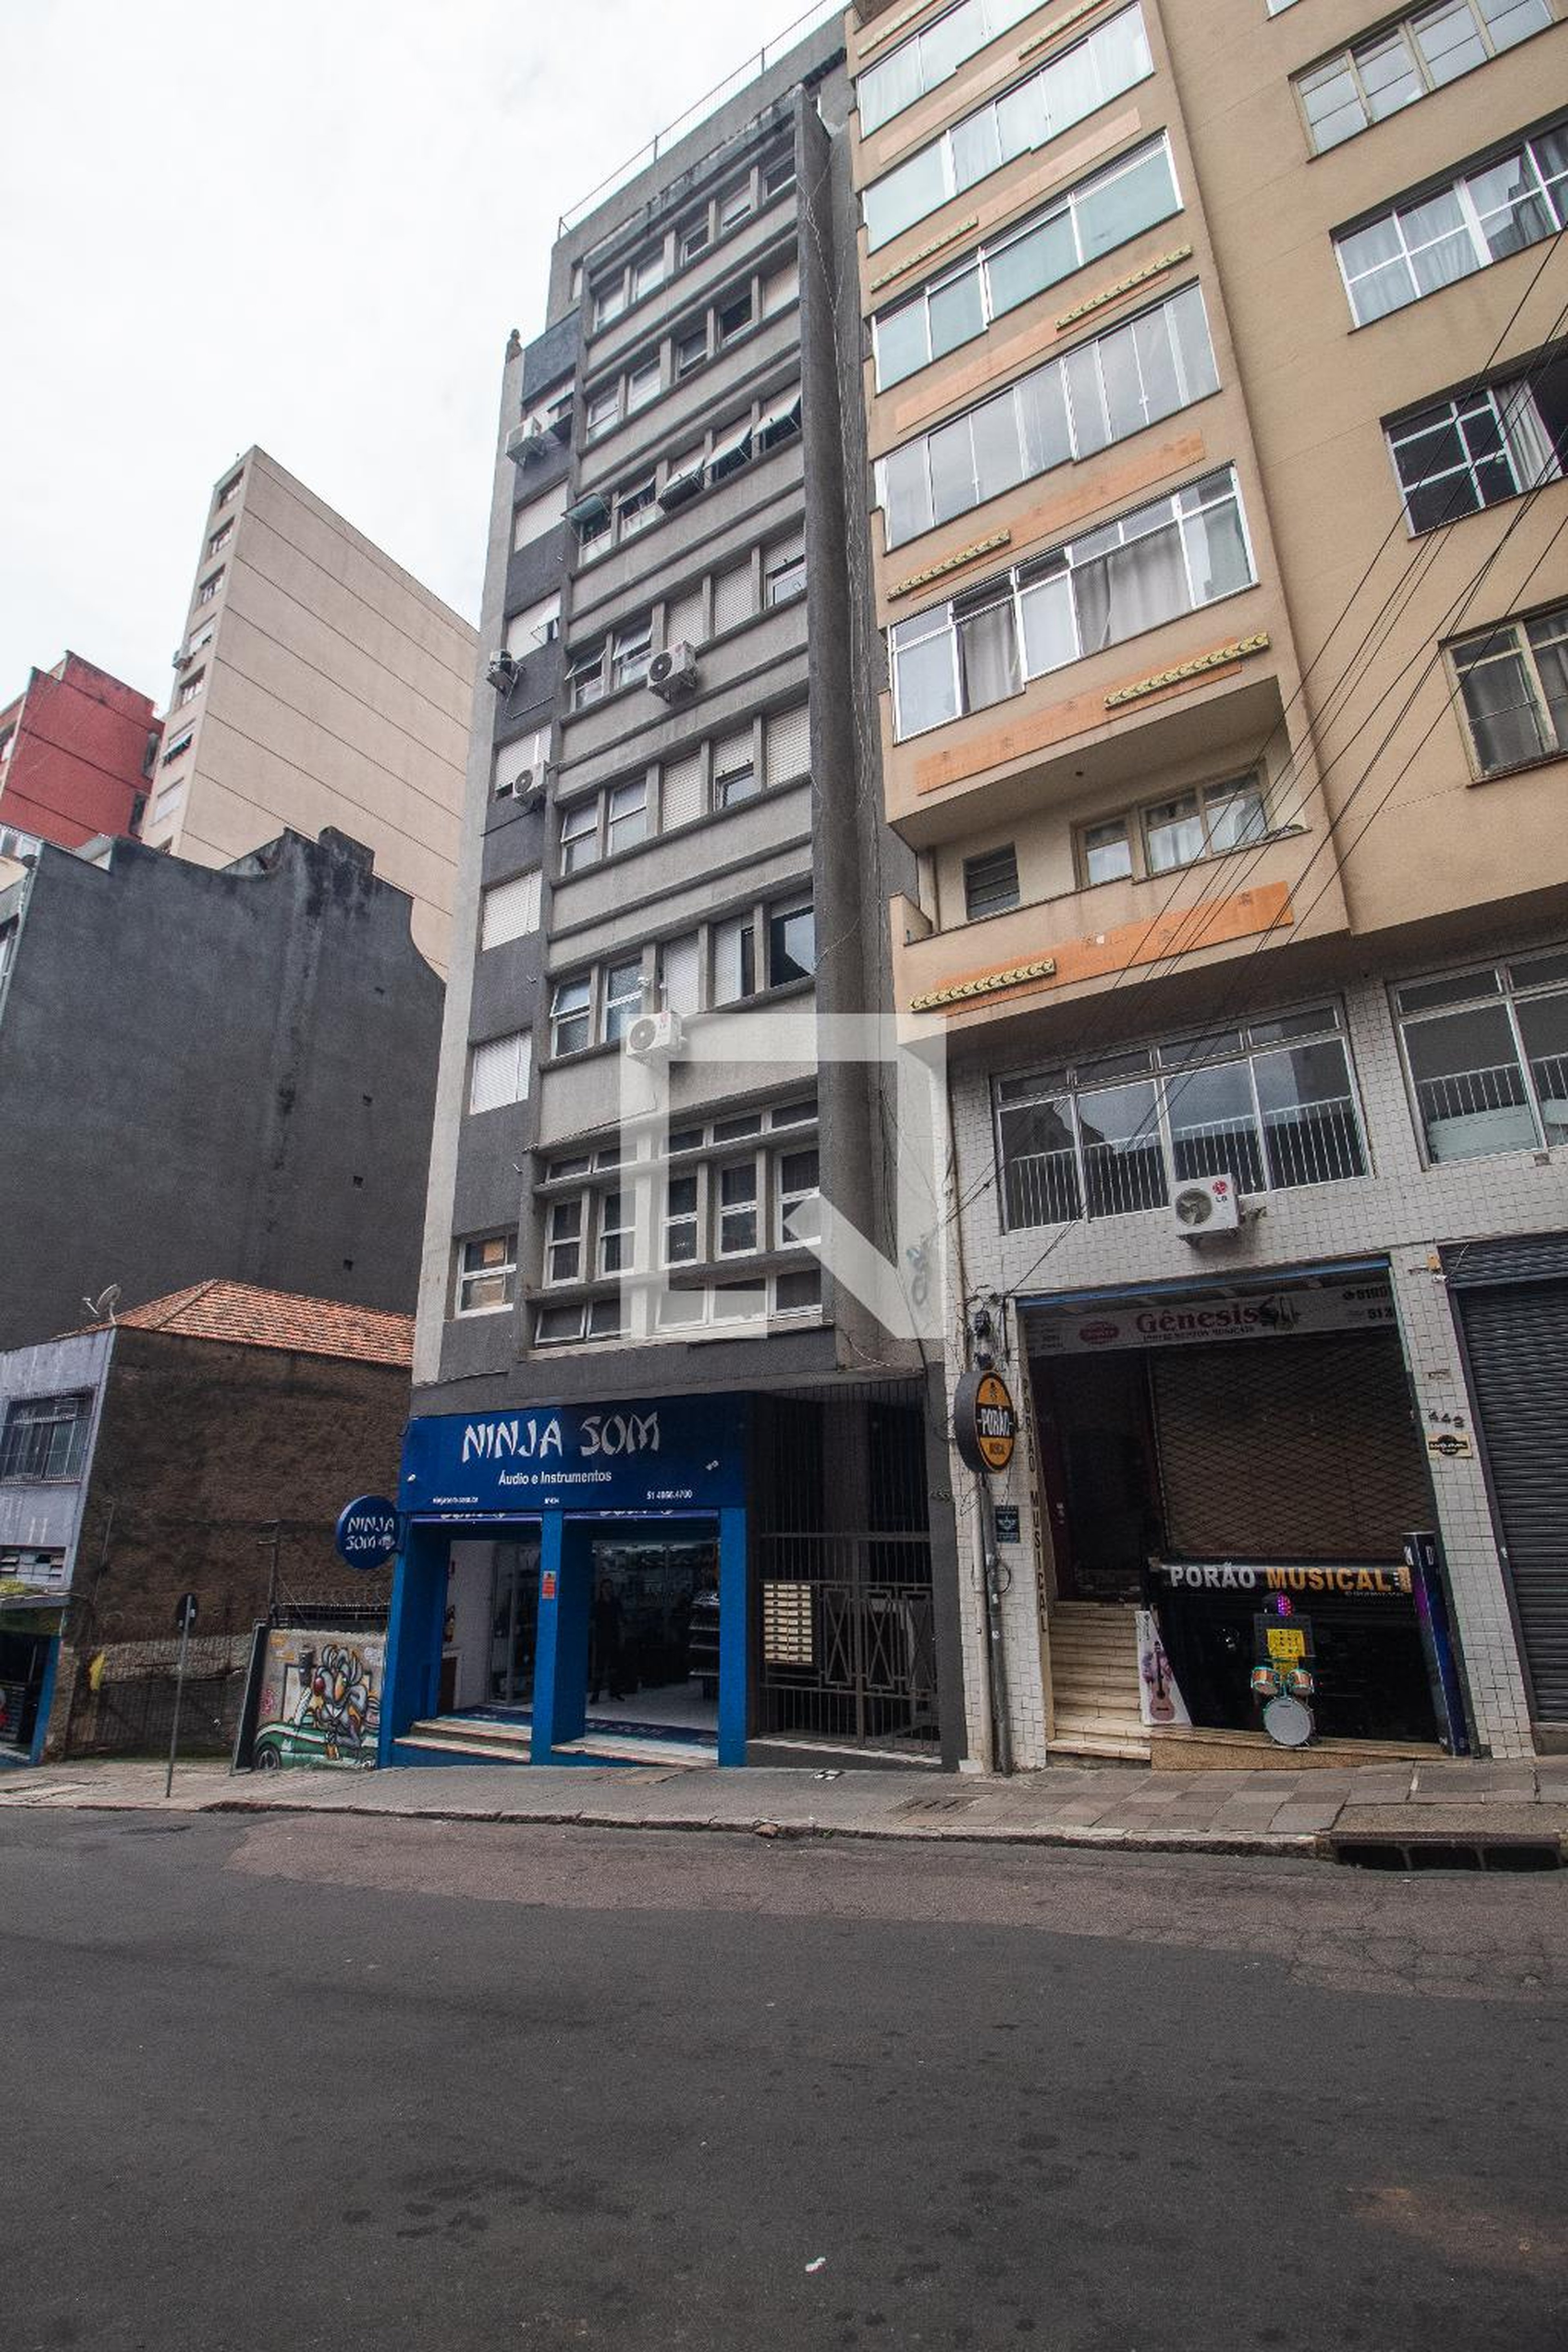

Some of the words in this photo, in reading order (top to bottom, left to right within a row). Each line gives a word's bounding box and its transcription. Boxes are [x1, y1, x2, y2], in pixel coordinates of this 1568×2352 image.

[1136, 1303, 1260, 1334] Gênesis
[980, 1405, 1010, 1437] PORÃO
[462, 1419, 563, 1463] NINJA
[580, 1411, 660, 1457] SOM
[498, 1469, 529, 1486] Áudio
[531, 1475, 538, 1485] e
[540, 1470, 612, 1484] Instrumentos
[347, 1517, 394, 1533] NINJA
[345, 1535, 376, 1550] SOM
[1030, 1490, 1047, 1632] MUSICAL
[1170, 1561, 1256, 1588] PORÃO
[1266, 1566, 1392, 1592] MUSICAL
